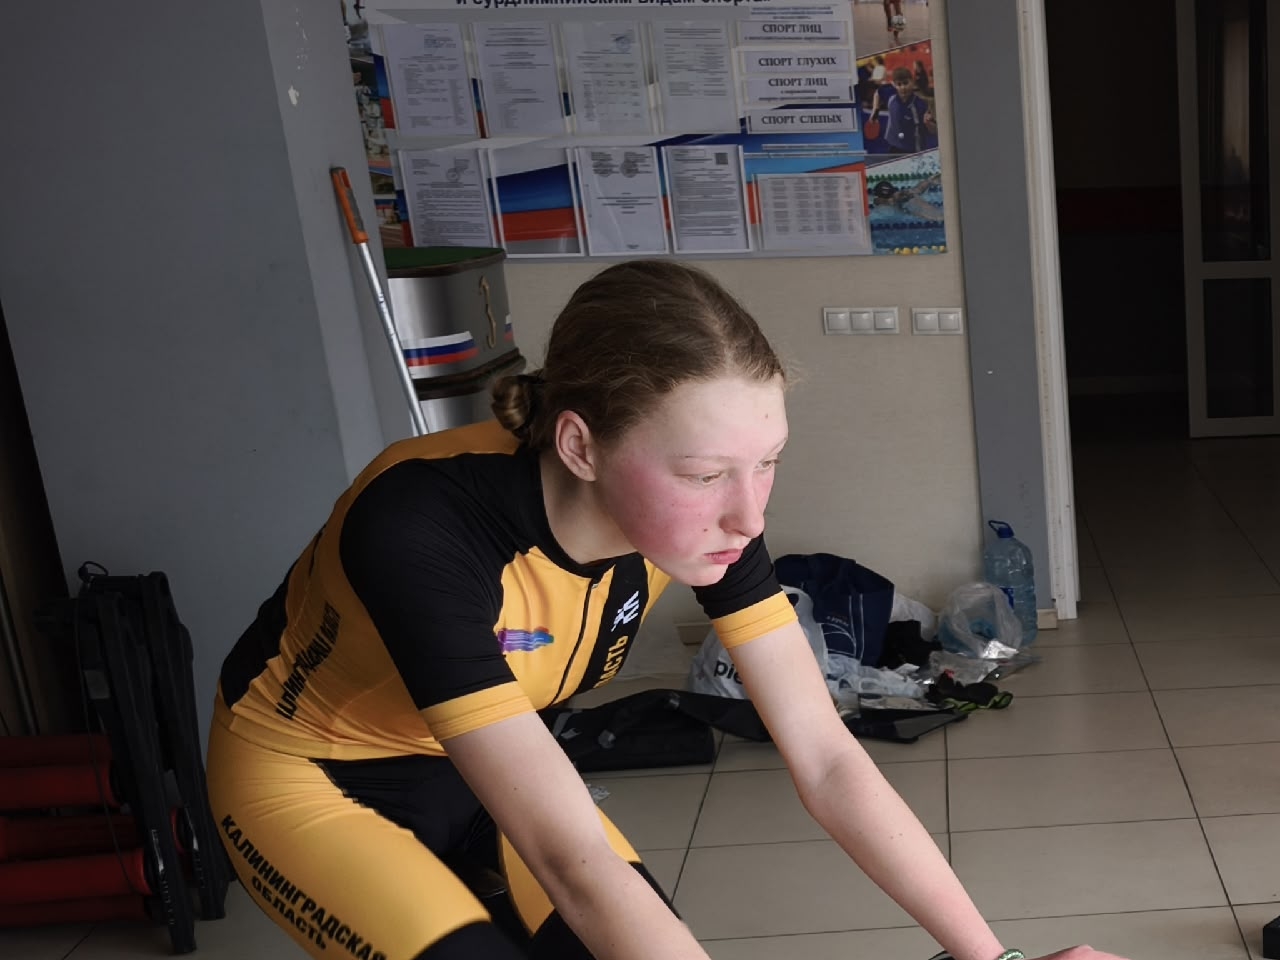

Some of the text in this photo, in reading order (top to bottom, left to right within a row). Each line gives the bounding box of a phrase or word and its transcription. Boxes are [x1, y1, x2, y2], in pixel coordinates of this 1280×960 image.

[762, 24, 823, 34] СПОРТ ЛИЦ
[758, 57, 837, 67] СПОРТ ГЛУХИХ
[768, 78, 828, 87] СПОРТ ЛИЦ
[761, 115, 842, 125] СПОРТ СЛЕПЫХ
[251, 875, 328, 951] ОБЛАСТЬ
